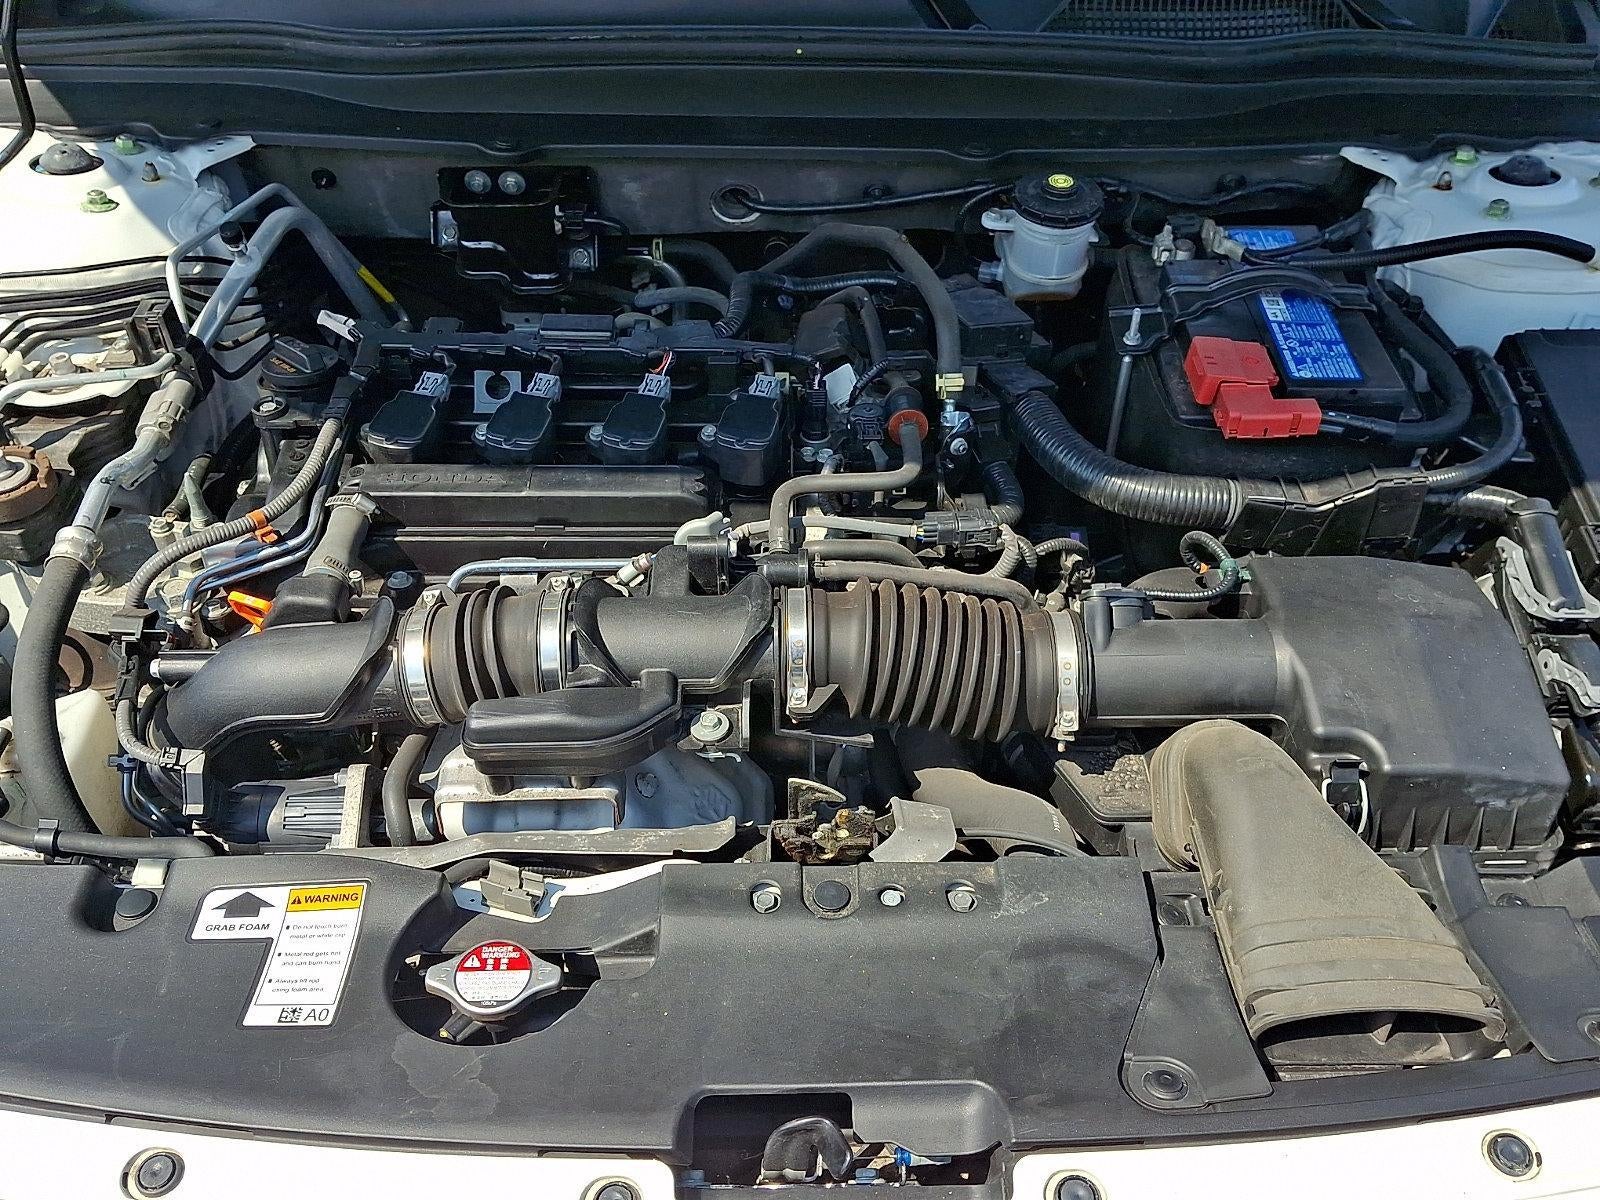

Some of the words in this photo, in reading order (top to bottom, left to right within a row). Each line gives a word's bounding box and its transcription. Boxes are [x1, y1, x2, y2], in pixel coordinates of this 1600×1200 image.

[304, 892, 359, 904] WARNING
[205, 924, 236, 932] GRAB
[239, 923, 270, 931] FOAM
[303, 1008, 329, 1022] A0
